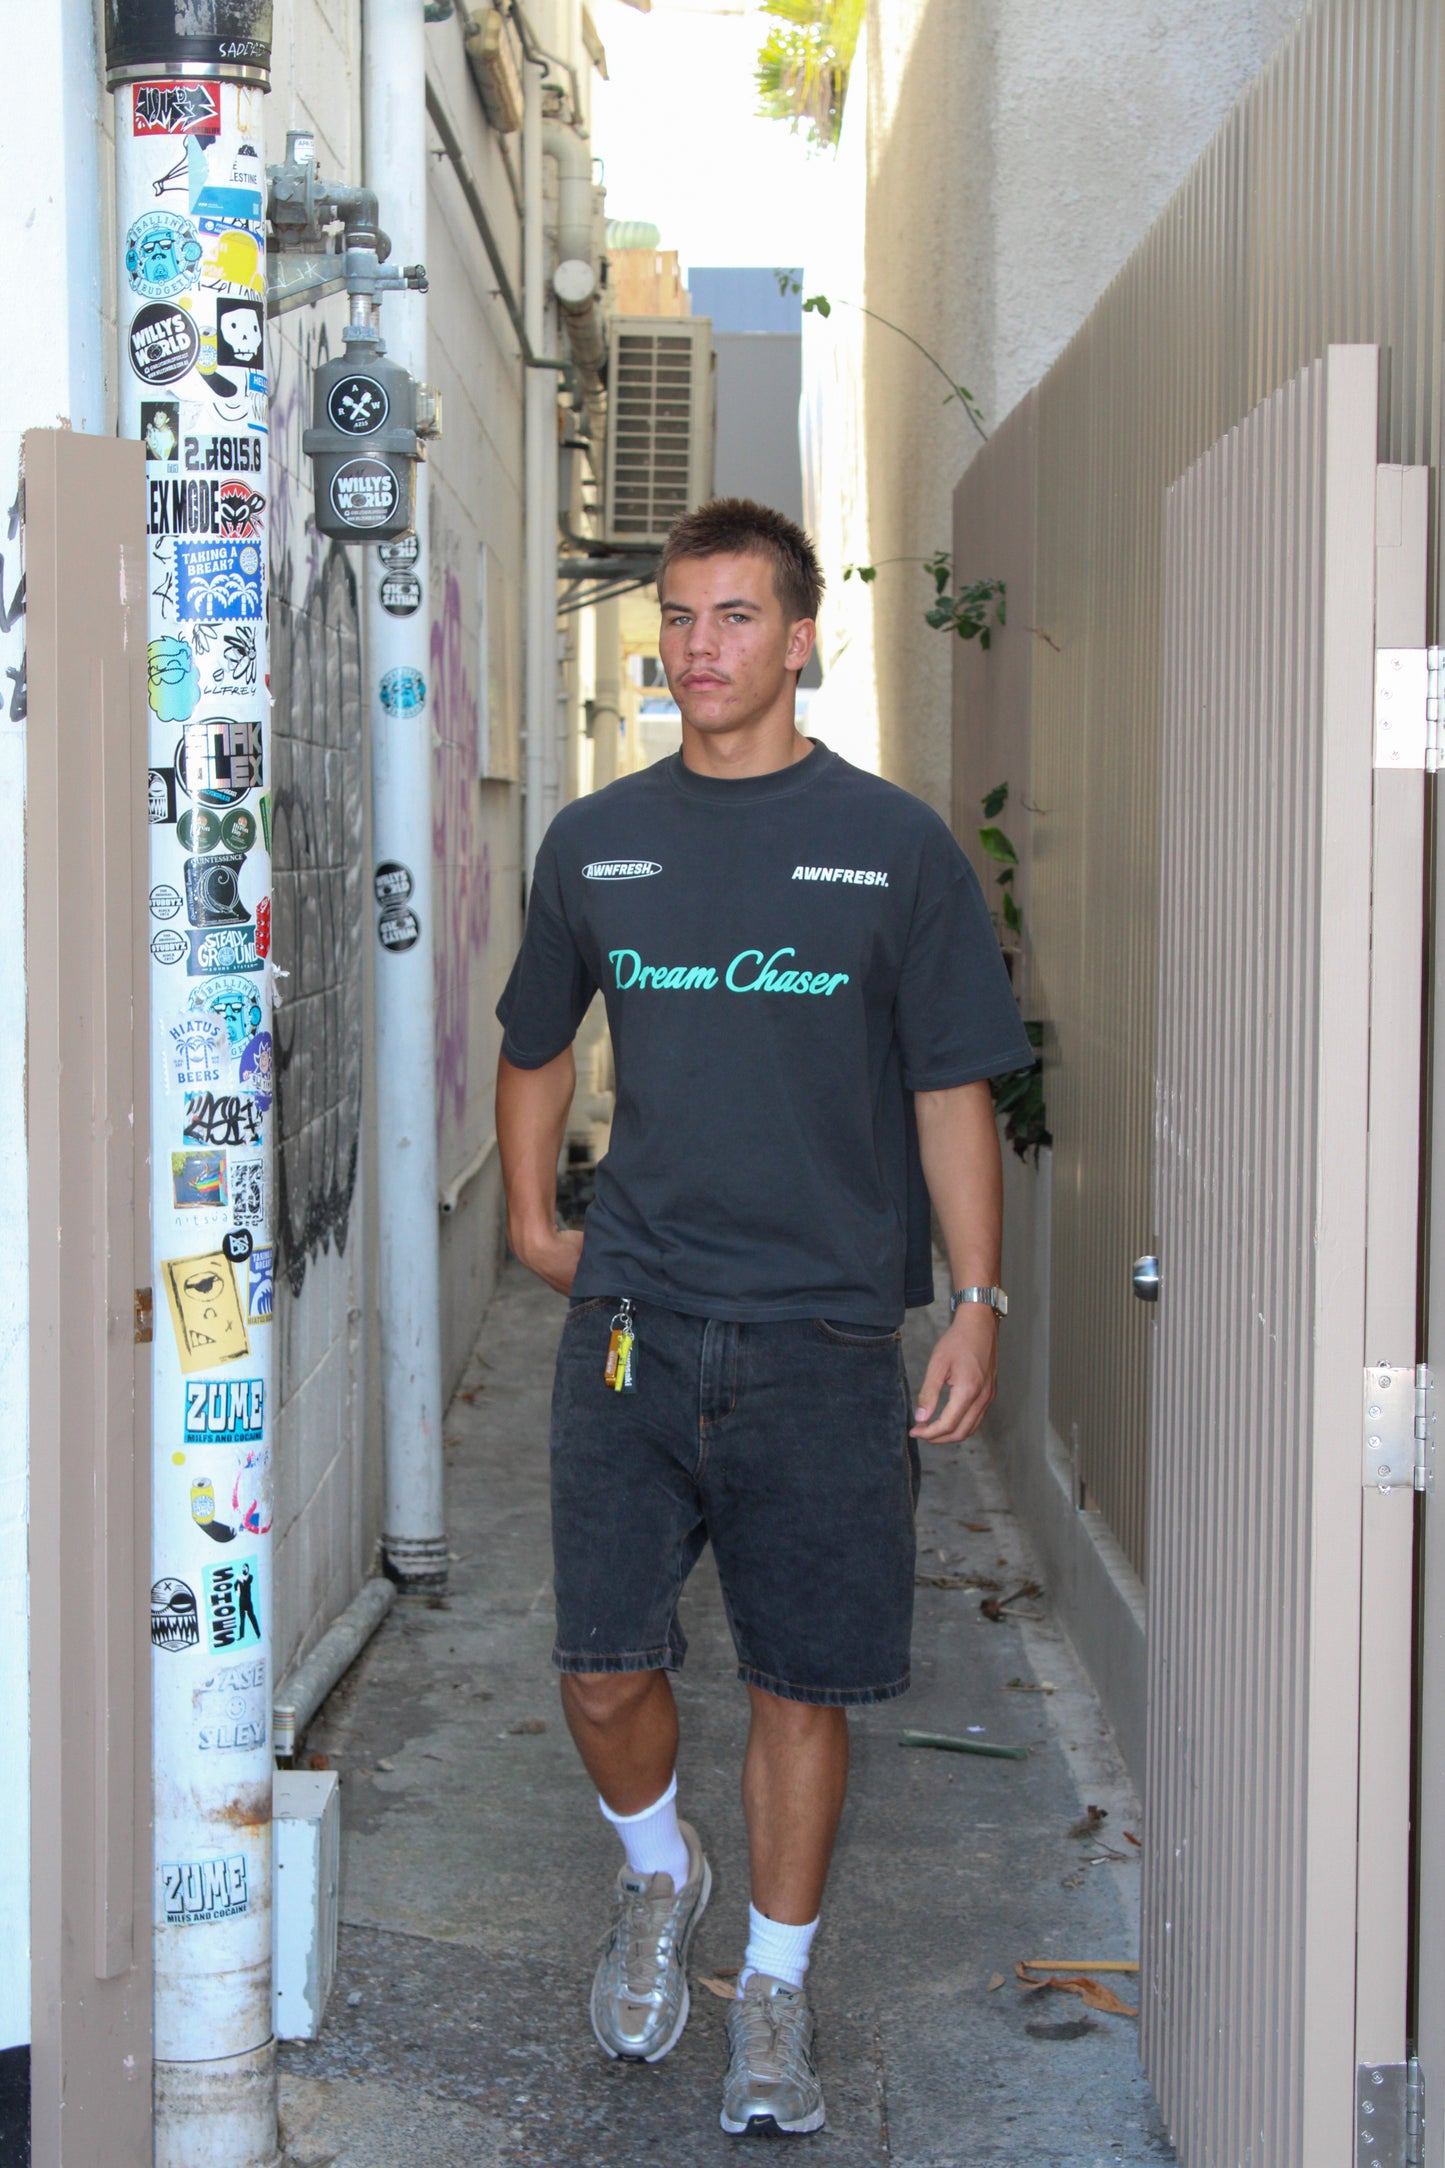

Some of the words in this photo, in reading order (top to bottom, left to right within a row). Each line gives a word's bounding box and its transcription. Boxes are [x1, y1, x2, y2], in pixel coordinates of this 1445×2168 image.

[141, 279, 184, 296] BUDGET
[131, 314, 186, 350] WILLYS
[337, 476, 392, 493] WILLYS
[337, 493, 393, 509] WORLD
[182, 547, 227, 565] TAKING
[230, 546, 238, 557] A
[188, 559, 234, 576] BREAK?
[791, 866, 889, 887] AWNFRESH.
[204, 930, 248, 949] STEADY
[197, 943, 259, 968] GROUND
[608, 949, 719, 990] Dream
[725, 947, 850, 996] Chaser
[169, 1020, 220, 1040] HIATUS
[178, 1069, 220, 1083] BEERS
[186, 1380, 263, 1433] ZUME
[215, 1434, 232, 1442] AND
[161, 1855, 248, 1915] ZUME
[193, 1912, 211, 1921] AND
[213, 1904, 247, 1919] COCAINE
